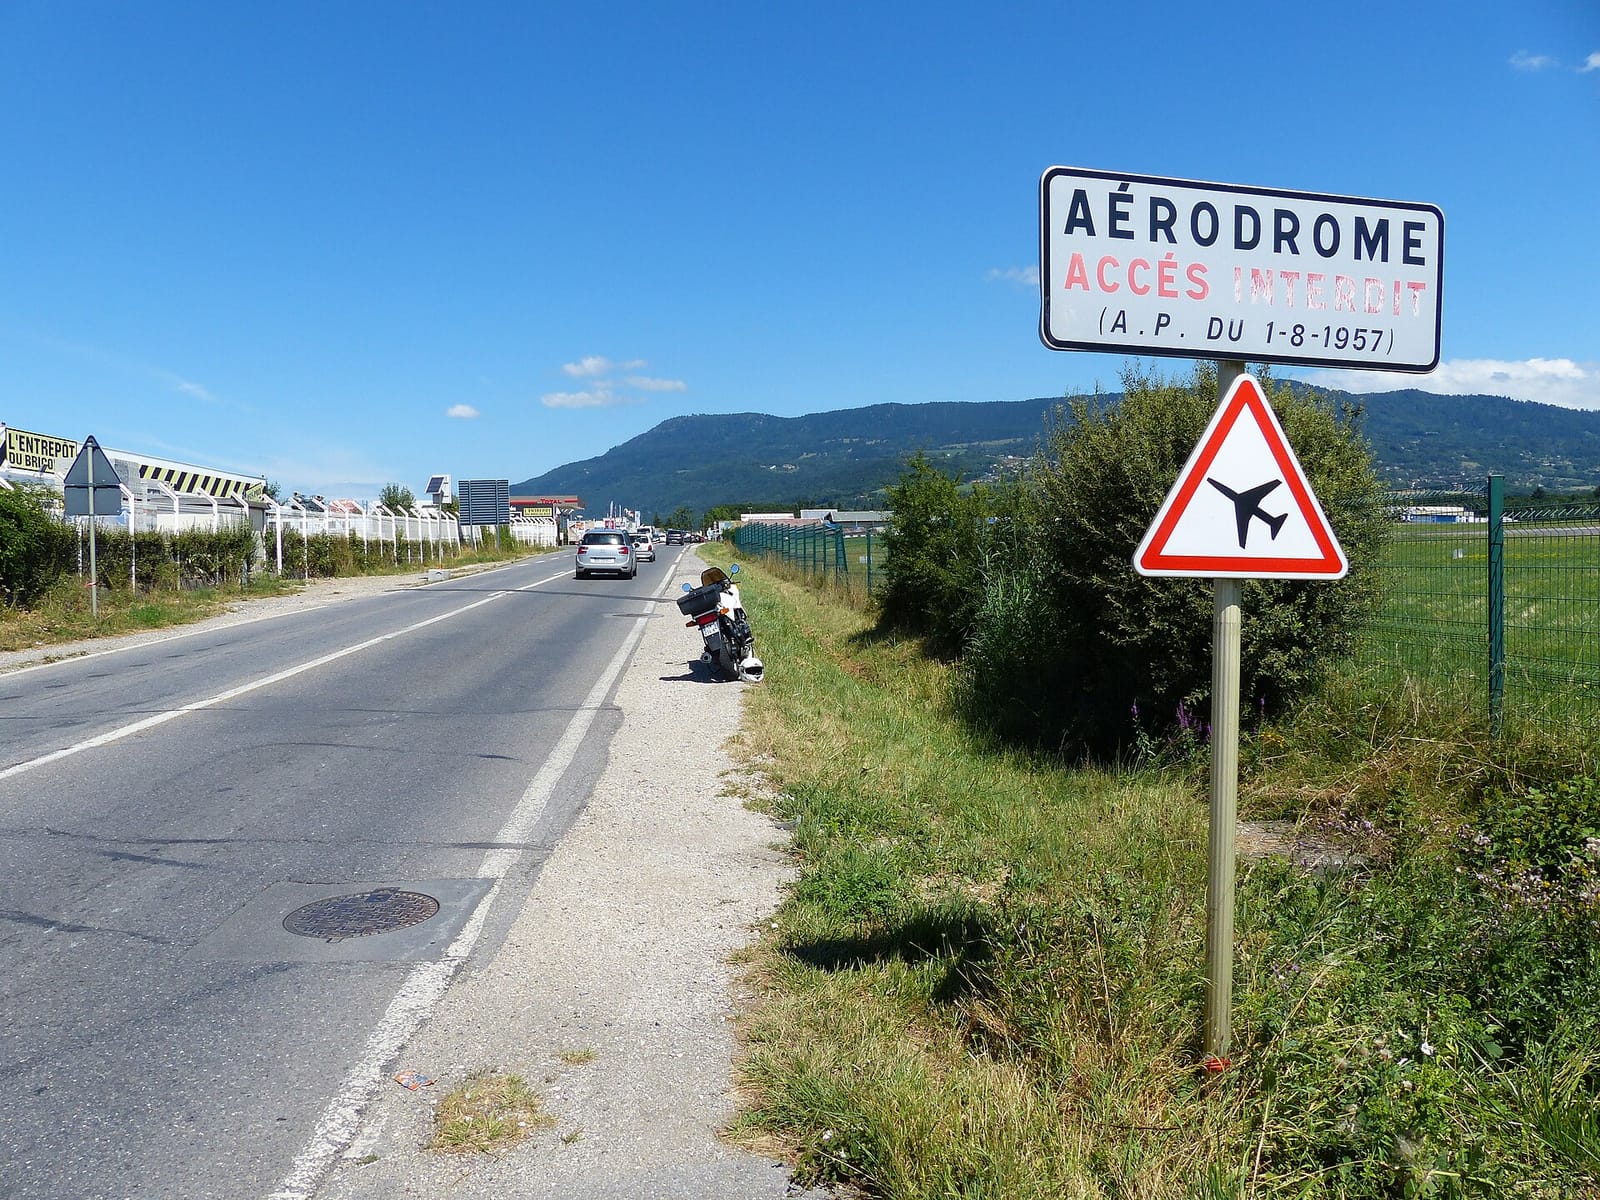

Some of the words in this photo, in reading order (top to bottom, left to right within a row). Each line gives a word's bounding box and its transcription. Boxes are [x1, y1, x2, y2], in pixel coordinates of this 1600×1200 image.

[1064, 182, 1426, 266] AÉRODROME
[1064, 252, 1210, 300] ACCÉS
[1234, 266, 1426, 318] INTERDIT
[1207, 316, 1244, 342] DU
[1265, 321, 1394, 355] 1-8-1957)
[9, 452, 22, 465] DU
